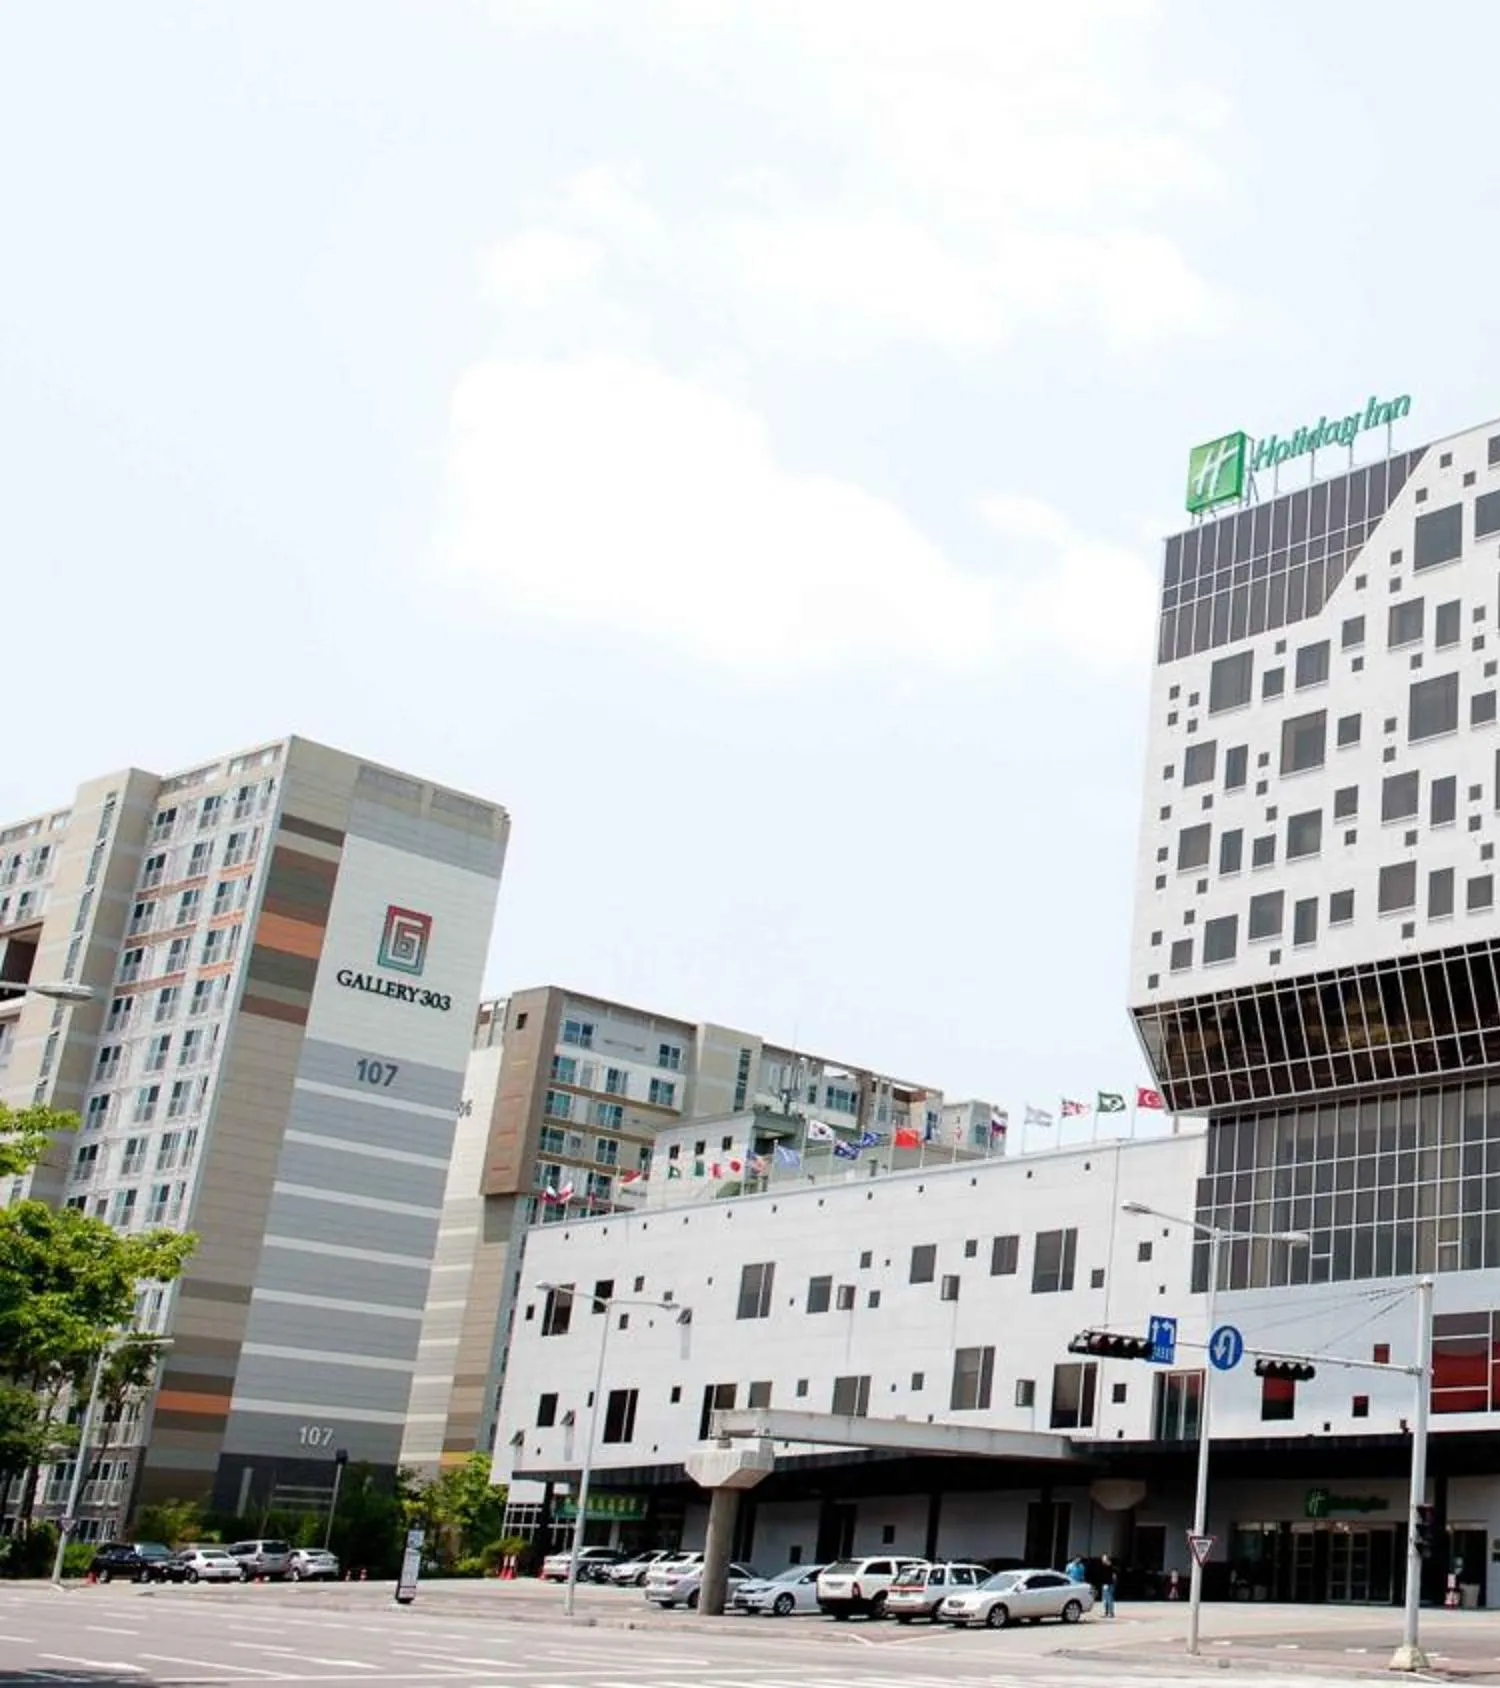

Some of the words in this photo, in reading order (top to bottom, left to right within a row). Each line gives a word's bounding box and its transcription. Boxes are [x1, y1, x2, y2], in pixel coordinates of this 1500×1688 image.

[1250, 411, 1363, 472] Holiday
[1364, 394, 1412, 431] Inn
[356, 1057, 399, 1087] 107
[299, 1425, 334, 1447] 107
